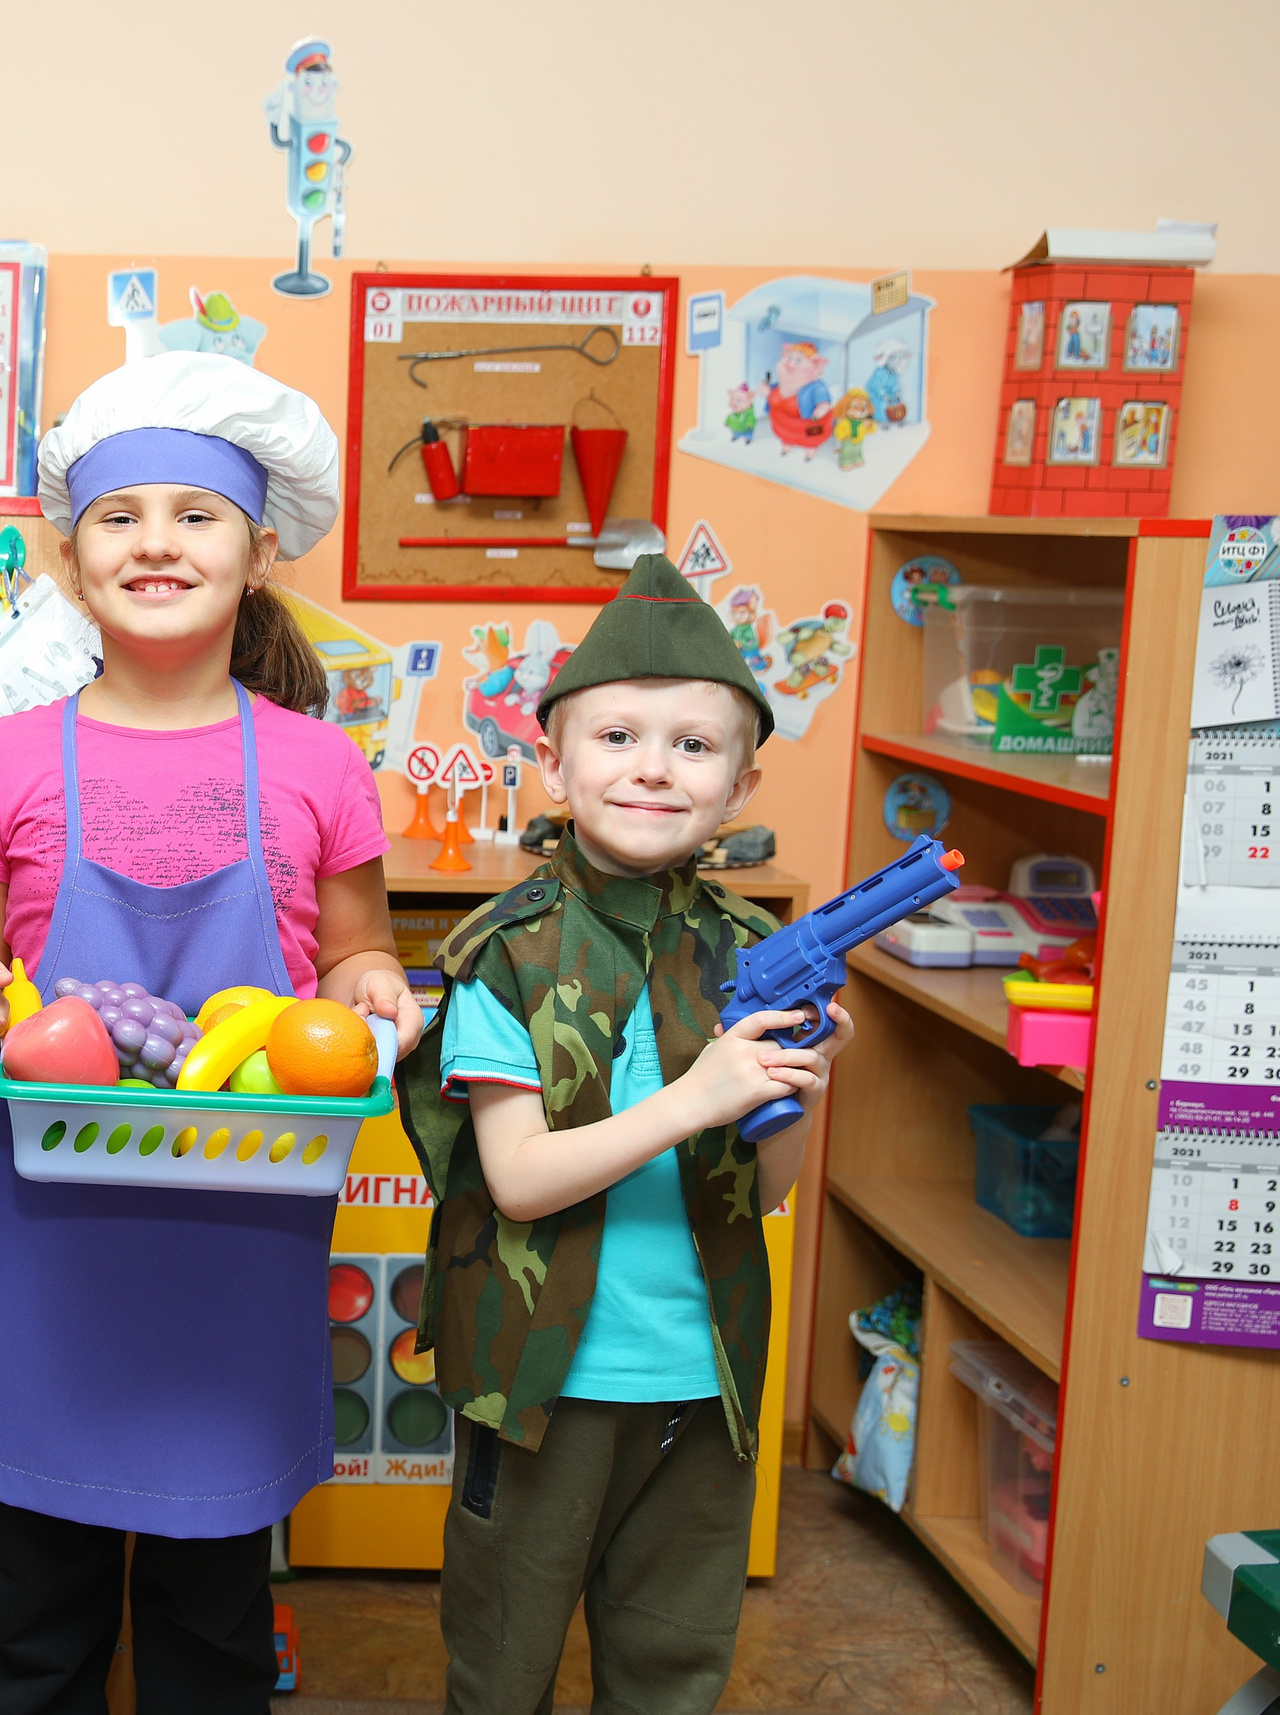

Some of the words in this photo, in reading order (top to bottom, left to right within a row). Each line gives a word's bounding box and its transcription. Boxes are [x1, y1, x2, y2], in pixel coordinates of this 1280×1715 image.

[407, 290, 553, 313] ПОЖАРНЫЙ
[561, 296, 617, 316] ЩИТ
[373, 322, 393, 338] 01
[627, 327, 659, 341] 112
[1222, 545, 1245, 556] ИТЦ
[1205, 751, 1233, 760] 2021
[1204, 780, 1226, 792] 06
[1264, 781, 1271, 793] 1
[1203, 801, 1225, 814] 07
[1261, 803, 1272, 815] 8
[1201, 823, 1224, 836] 08
[1251, 825, 1271, 837] 15
[1247, 846, 1270, 859] 22
[1188, 951, 1217, 960] 2021
[1185, 978, 1209, 991] 45
[1248, 981, 1254, 992] 1
[1183, 1000, 1207, 1012] 46
[1244, 1003, 1255, 1015] 8
[1181, 1021, 1205, 1033] 47
[1233, 1024, 1253, 1035] 15
[1270, 1025, 1280, 1037] 1
[1179, 1042, 1203, 1055] 48
[1229, 1045, 1251, 1057] 22
[1266, 1046, 1280, 1058] 2
[1177, 1063, 1201, 1075] 49
[1227, 1066, 1249, 1078] 29
[1172, 1147, 1201, 1157] 2021
[1171, 1174, 1192, 1186] 10
[1232, 1178, 1239, 1189] 1
[1267, 1179, 1277, 1191] 2
[338, 1176, 433, 1205] ИГН
[1170, 1195, 1189, 1207] 11
[1228, 1199, 1239, 1211] 8
[1265, 1201, 1276, 1213] 9
[1169, 1216, 1189, 1228] 12
[1218, 1220, 1237, 1231] 15
[1254, 1221, 1274, 1233] 16
[1167, 1237, 1187, 1249] 13
[1214, 1241, 1235, 1252] 22
[1250, 1242, 1272, 1255] 23
[1211, 1261, 1234, 1273] 29
[1248, 1263, 1270, 1275] 30
[333, 1458, 369, 1476] ой!
[385, 1459, 446, 1480] Жди!
